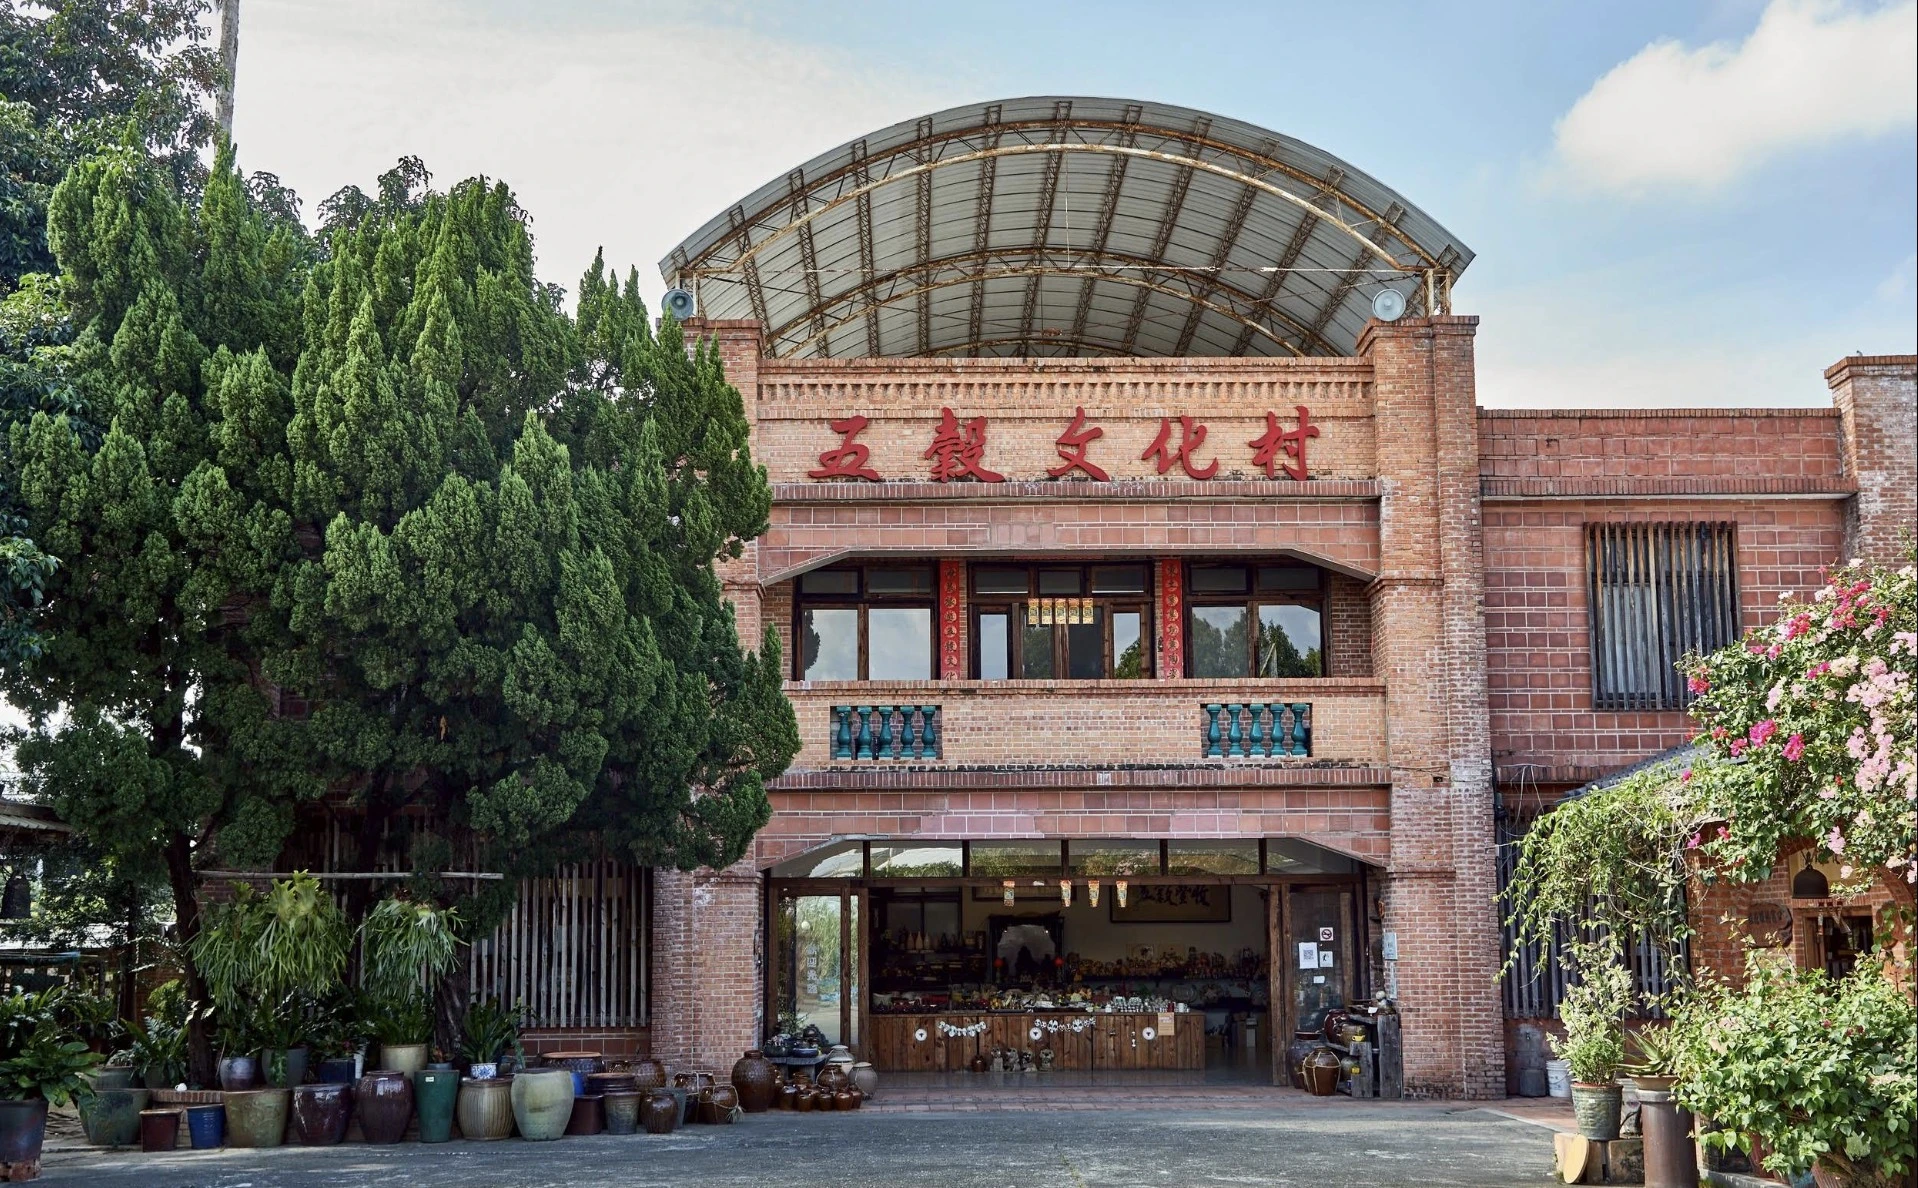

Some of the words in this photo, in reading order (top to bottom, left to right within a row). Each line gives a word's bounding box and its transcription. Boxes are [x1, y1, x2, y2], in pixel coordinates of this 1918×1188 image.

[807, 406, 1320, 483] 五穀文化村
